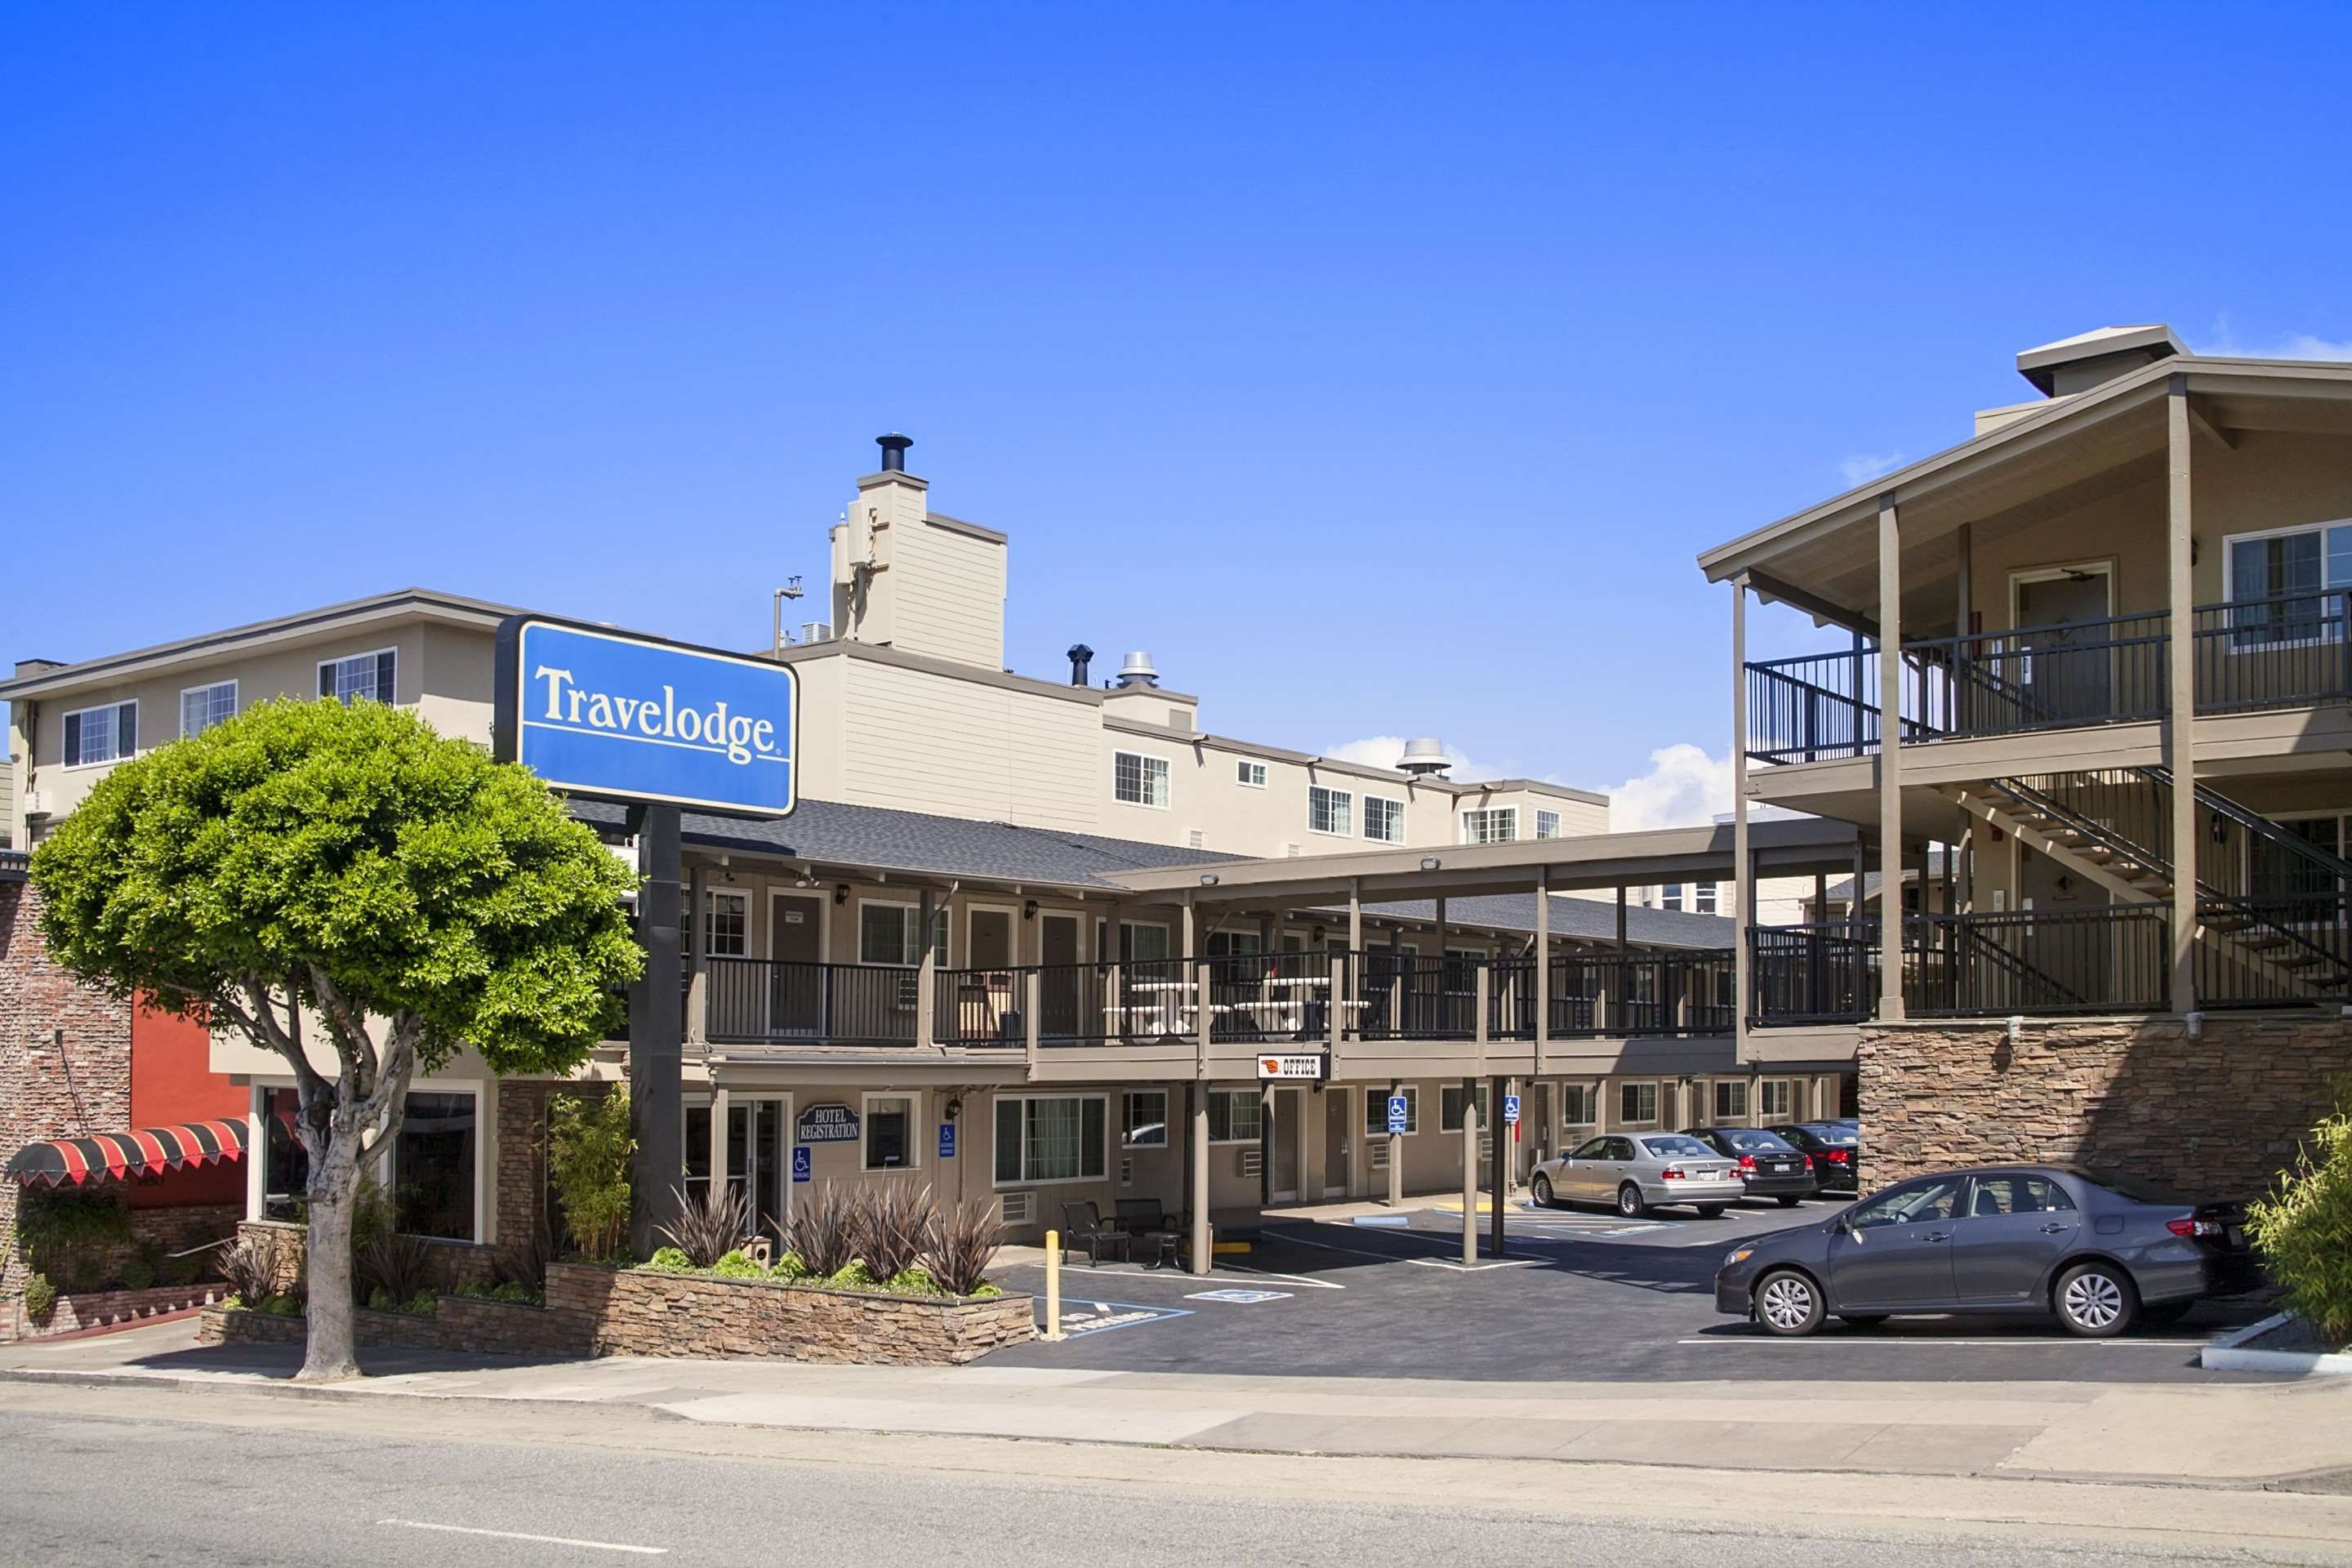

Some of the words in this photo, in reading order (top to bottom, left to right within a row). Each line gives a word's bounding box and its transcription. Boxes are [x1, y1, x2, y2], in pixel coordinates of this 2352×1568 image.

[535, 665, 775, 765] Travelodge
[1283, 1058, 1316, 1076] OFFICE
[816, 1109, 847, 1124] HOTEL
[800, 1123, 858, 1139] REGISTRATION
